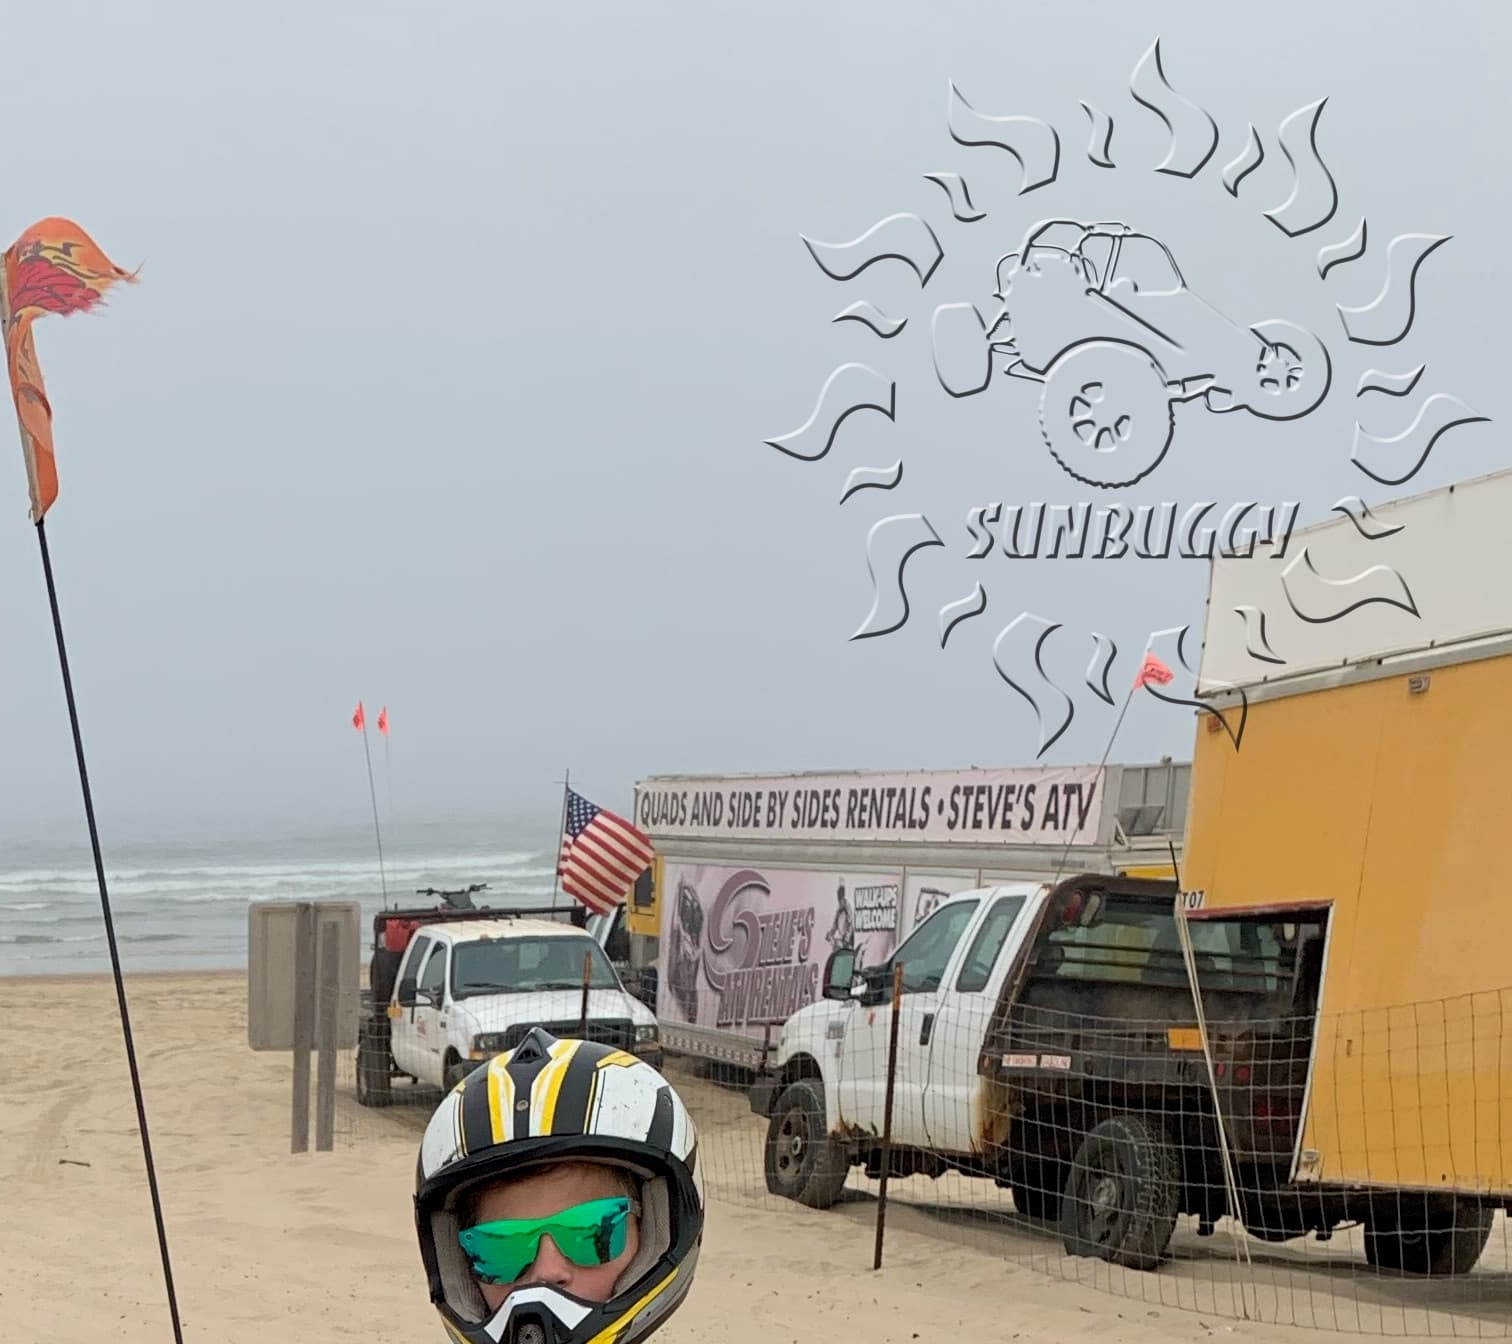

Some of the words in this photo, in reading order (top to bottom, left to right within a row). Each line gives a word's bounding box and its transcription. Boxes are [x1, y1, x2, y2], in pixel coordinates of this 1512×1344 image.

[641, 791, 687, 827] QUADS
[690, 791, 723, 826] AND
[728, 791, 763, 828] SIDE
[767, 790, 788, 828] BY
[791, 788, 841, 829] SIDES
[846, 786, 931, 830] RENTALS
[947, 784, 1036, 830] STEVE'S
[1041, 783, 1096, 831] ATV
